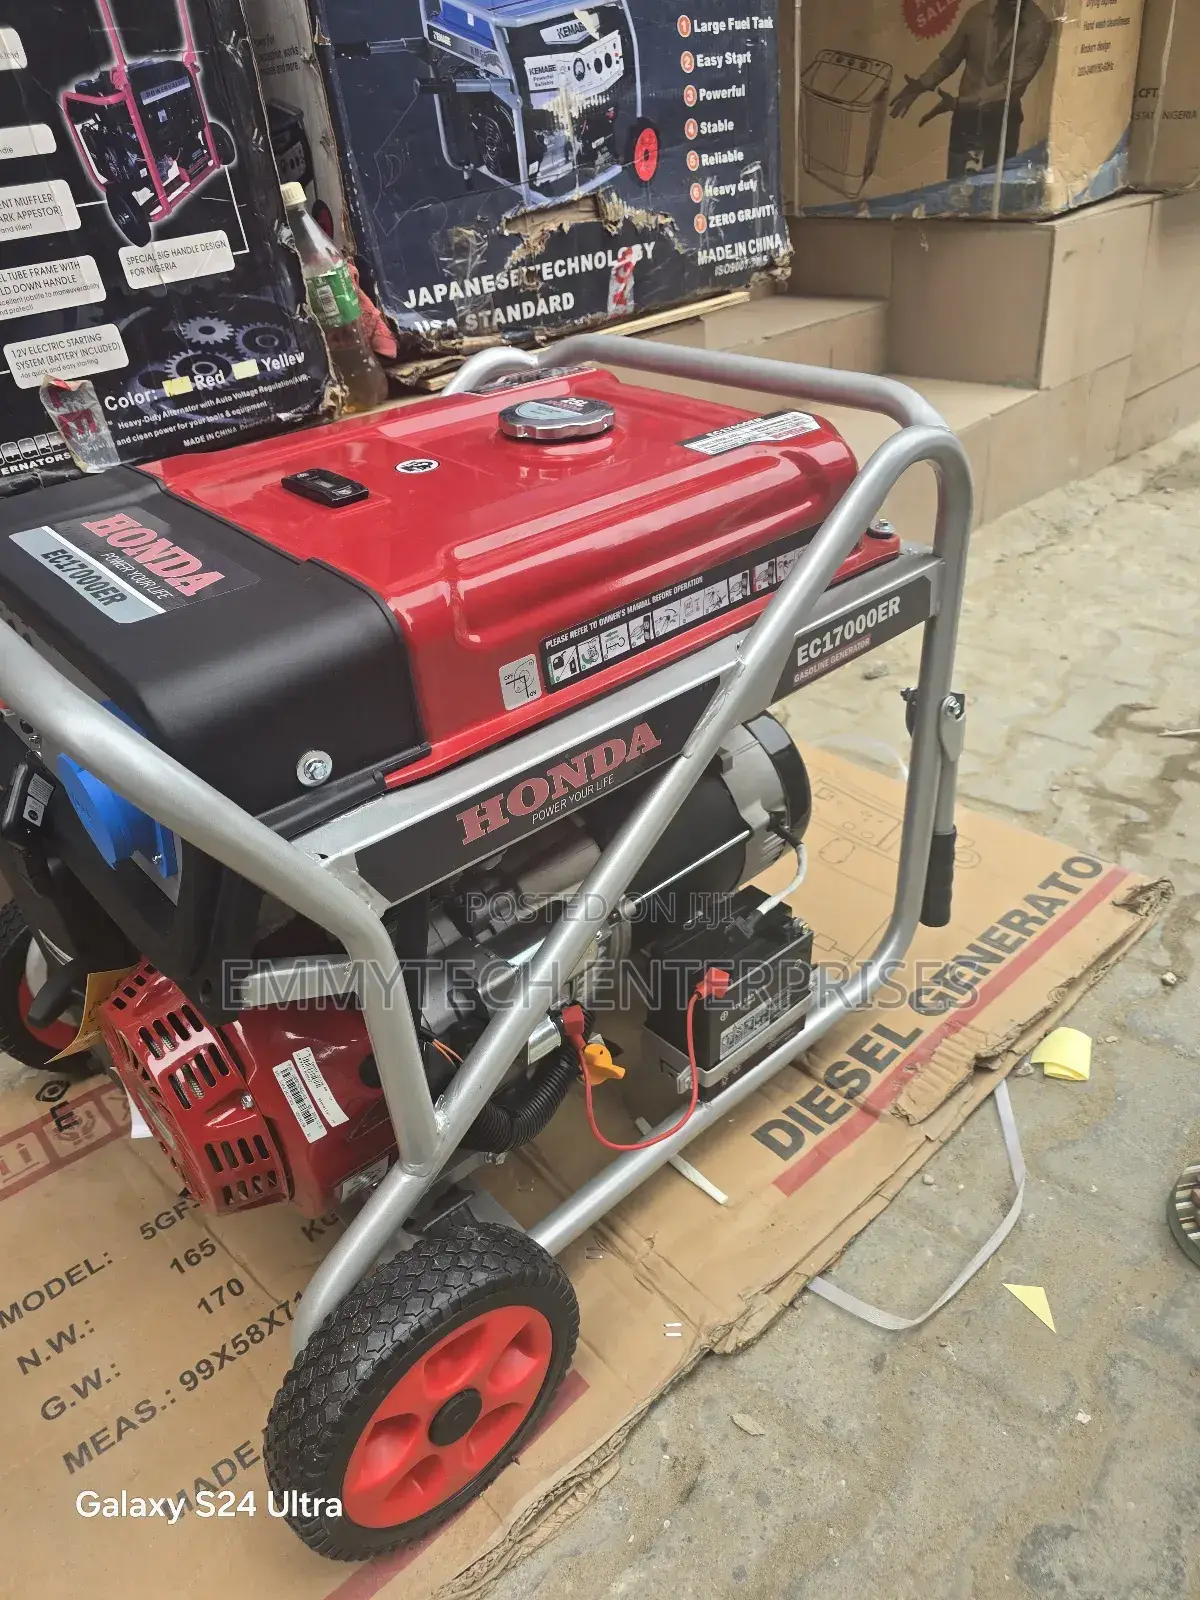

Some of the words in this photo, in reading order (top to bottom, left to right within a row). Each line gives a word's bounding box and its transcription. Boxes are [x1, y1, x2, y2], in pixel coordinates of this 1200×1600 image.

[556, 21, 588, 39] KEMAG
[693, 20, 726, 35] Large
[727, 17, 750, 31] Fuel
[752, 16, 773, 29] Tank
[696, 54, 723, 69] Easy
[725, 51, 752, 65] Start
[699, 84, 746, 101] Powerful
[700, 119, 735, 135] Stable
[1162, 110, 1198, 120] NIGERIA
[700, 149, 745, 167] Reliable
[704, 183, 736, 197] Heavy
[737, 178, 758, 192] duty
[15, 194, 54, 208] MUFFLER
[708, 212, 737, 228] ZERO
[126, 251, 157, 266] SPECIAL
[157, 248, 170, 261] BIG
[170, 244, 200, 258] HANDLE
[200, 239, 227, 253] DESIGN
[697, 245, 733, 266] MADE
[734, 240, 747, 258] IN
[748, 233, 783, 255] CHINA
[7, 270, 28, 281] TUBE
[29, 263, 58, 278] FRAME
[59, 260, 81, 272] WITH
[130, 266, 145, 277] FOR
[145, 261, 178, 276] NIGERIA
[13, 280, 42, 293] DOWN
[43, 274, 78, 287] HANDLE
[403, 268, 521, 309] JAPANESE
[464, 291, 575, 332] STANDARD
[11, 347, 28, 359] 12V
[28, 340, 66, 355] ELECTRIC
[66, 333, 102, 348] STARTING
[15, 357, 45, 371] SYSTEM
[32, 367, 49, 379] quick
[49, 365, 62, 374] and
[193, 370, 225, 391] Red
[105, 389, 158, 411] Color:
[118, 413, 162, 429] Heavy-Duty
[162, 404, 199, 419] Alternator
[199, 400, 215, 409] with
[215, 395, 232, 405] Auto
[232, 388, 258, 400] Voltage
[116, 435, 132, 446] and
[132, 431, 153, 442] clean
[154, 425, 177, 437] power
[177, 422, 188, 430] for
[189, 417, 206, 429] your
[206, 413, 224, 423] tools
[183, 434, 206, 447] MADE
[206, 433, 215, 442] IN
[215, 425, 238, 440] CHINA
[81, 512, 226, 597] HONDA
[41, 548, 128, 607] EC17000ER
[101, 552, 133, 574] POWER
[131, 570, 157, 589] YOUR
[148, 584, 174, 601] LIFE
[545, 633, 569, 650] PLEASE
[569, 625, 589, 639] REFER
[589, 619, 598, 631] TO
[598, 608, 626, 627] OWNER'S
[627, 598, 651, 616] MANUAL
[651, 588, 673, 605] BEFORE
[673, 575, 704, 597] OPERATION
[797, 595, 901, 667] EC17000ER
[794, 657, 830, 683] GASOLINE
[830, 637, 870, 664] GENERATOR
[456, 721, 662, 846] HONDA
[532, 798, 567, 825] POWER
[568, 784, 595, 805] YOUR
[596, 773, 615, 791] LIFE
[750, 1021, 924, 1162] DIESEL
[0, 1250, 114, 1330] MODEL:
[16, 1319, 96, 1376] N.W.:
[169, 1237, 217, 1276] 165
[40, 1361, 122, 1422] G.W.:
[197, 1277, 246, 1316] 170
[62, 1388, 178, 1475] MEAS.:
